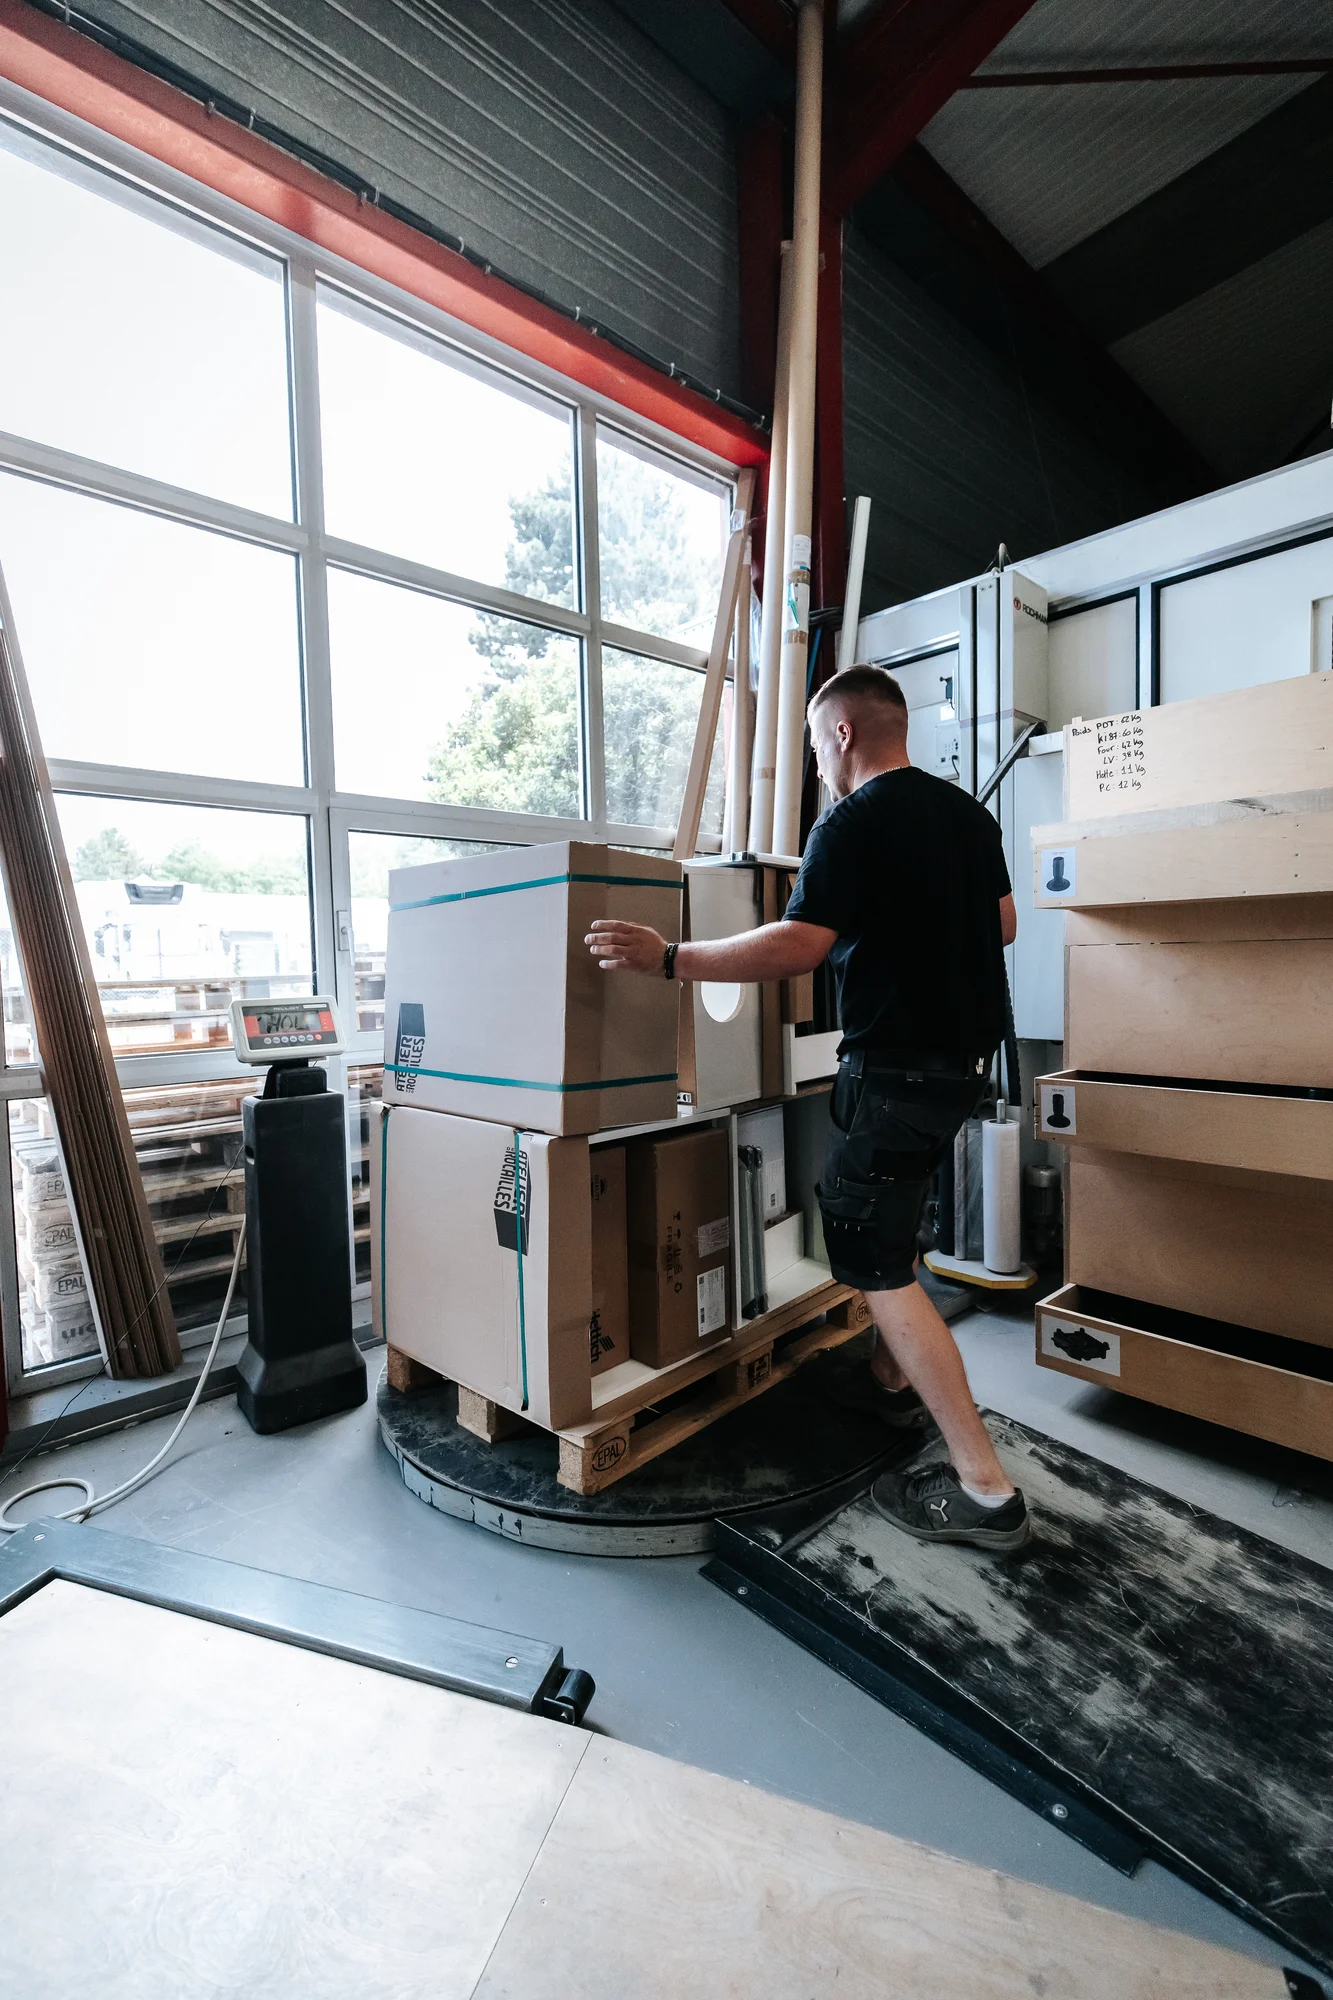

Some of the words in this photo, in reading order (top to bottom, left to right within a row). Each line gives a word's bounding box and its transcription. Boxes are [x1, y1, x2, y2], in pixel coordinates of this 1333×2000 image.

[1121, 740, 1131, 750] 42
[1133, 738, 1144, 749] Kg
[1121, 751, 1131, 762] 38
[1134, 749, 1145, 760] Kg
[1135, 764, 1147, 777] Kg
[1117, 780, 1128, 789] 12
[1131, 778, 1142, 791] Kg
[396, 1036, 413, 1092] ATEIER
[406, 1038, 425, 1090] ROCILLES
[58, 1276, 87, 1293] EPAL
[598, 1442, 622, 1467] EPAL
